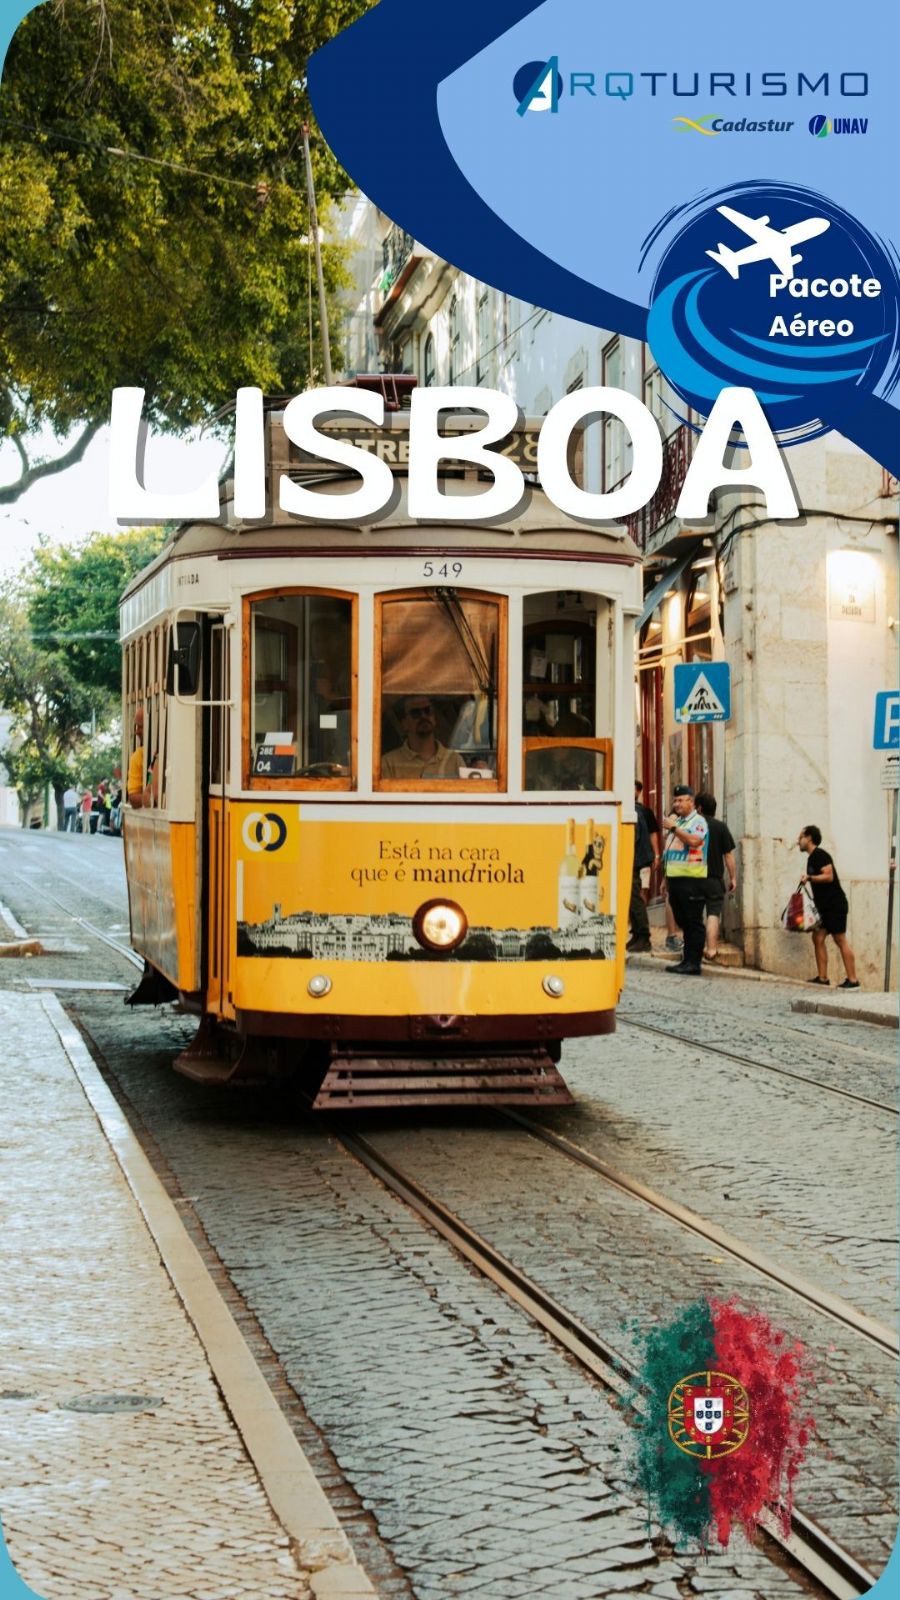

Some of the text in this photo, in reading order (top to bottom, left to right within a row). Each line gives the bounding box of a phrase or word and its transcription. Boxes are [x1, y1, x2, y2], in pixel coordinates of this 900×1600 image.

[423, 561, 463, 578] 549
[256, 760, 271, 772] 04
[378, 839, 500, 861] Está na cara
[350, 861, 525, 887] que é mandriola
